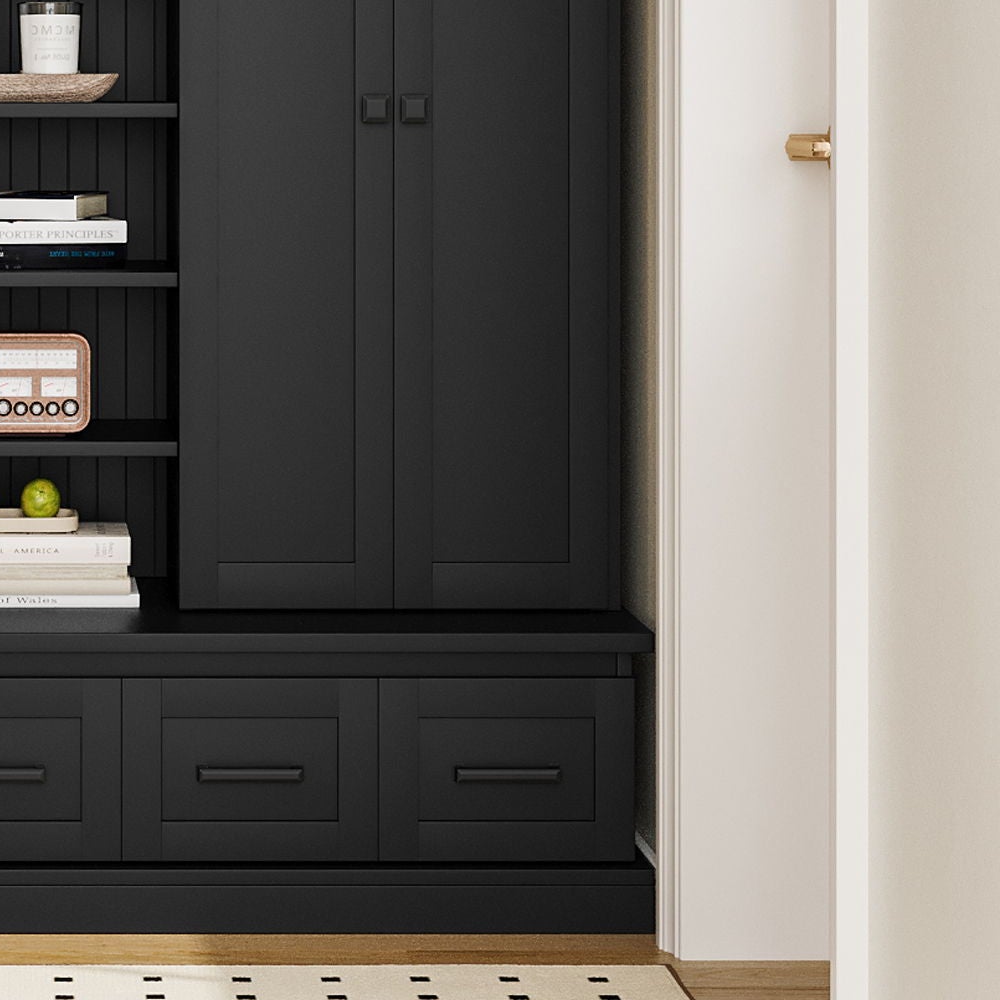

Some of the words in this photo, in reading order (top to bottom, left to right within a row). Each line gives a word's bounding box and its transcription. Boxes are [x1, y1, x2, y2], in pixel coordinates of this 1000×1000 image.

[46, 230, 114, 240] PRINCIPLES
[14, 547, 60, 555] AMERICA
[17, 596, 58, 605] Wales
